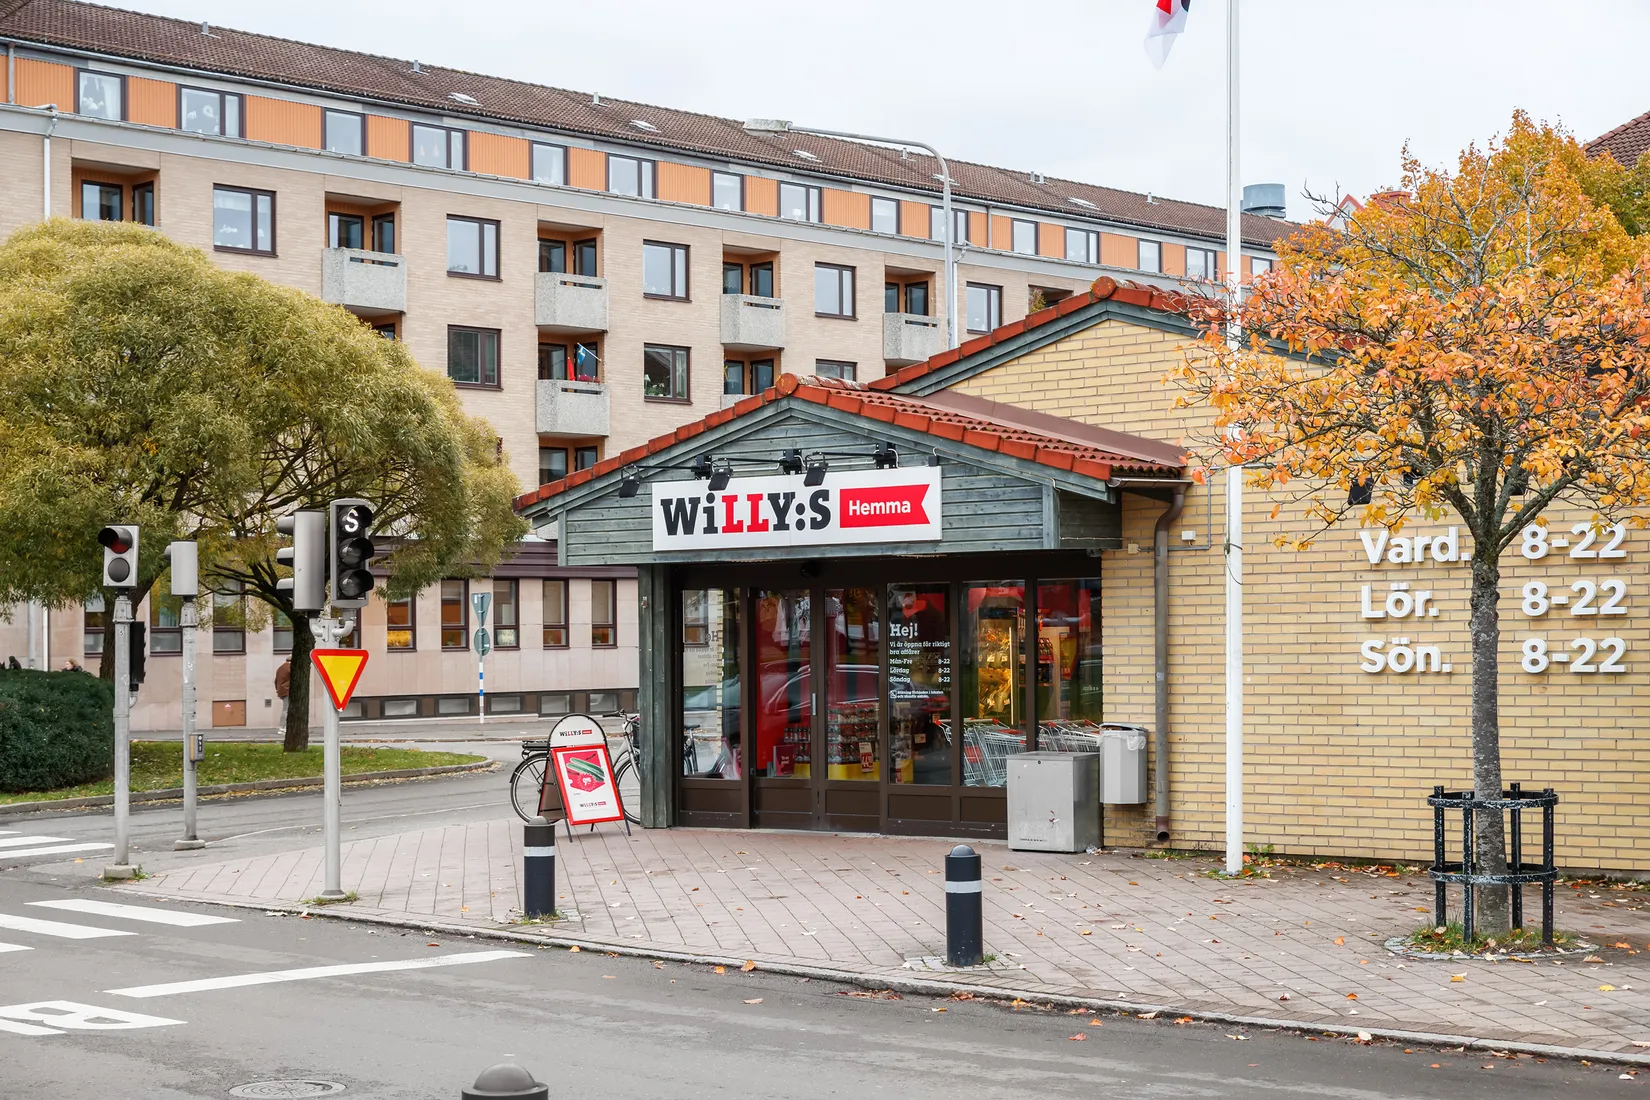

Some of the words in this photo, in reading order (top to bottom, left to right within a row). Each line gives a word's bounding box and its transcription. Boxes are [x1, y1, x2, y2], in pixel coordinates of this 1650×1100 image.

[344, 509, 359, 532] S
[848, 498, 912, 516] Hemma
[1359, 526, 1472, 564] Vard.
[1521, 522, 1627, 560] 8-22
[1361, 582, 1440, 619] Lör.
[1521, 579, 1628, 617] 8-22
[890, 622, 918, 638] Hej!
[1360, 636, 1453, 673] Sön.
[1521, 637, 1627, 674] 8-22
